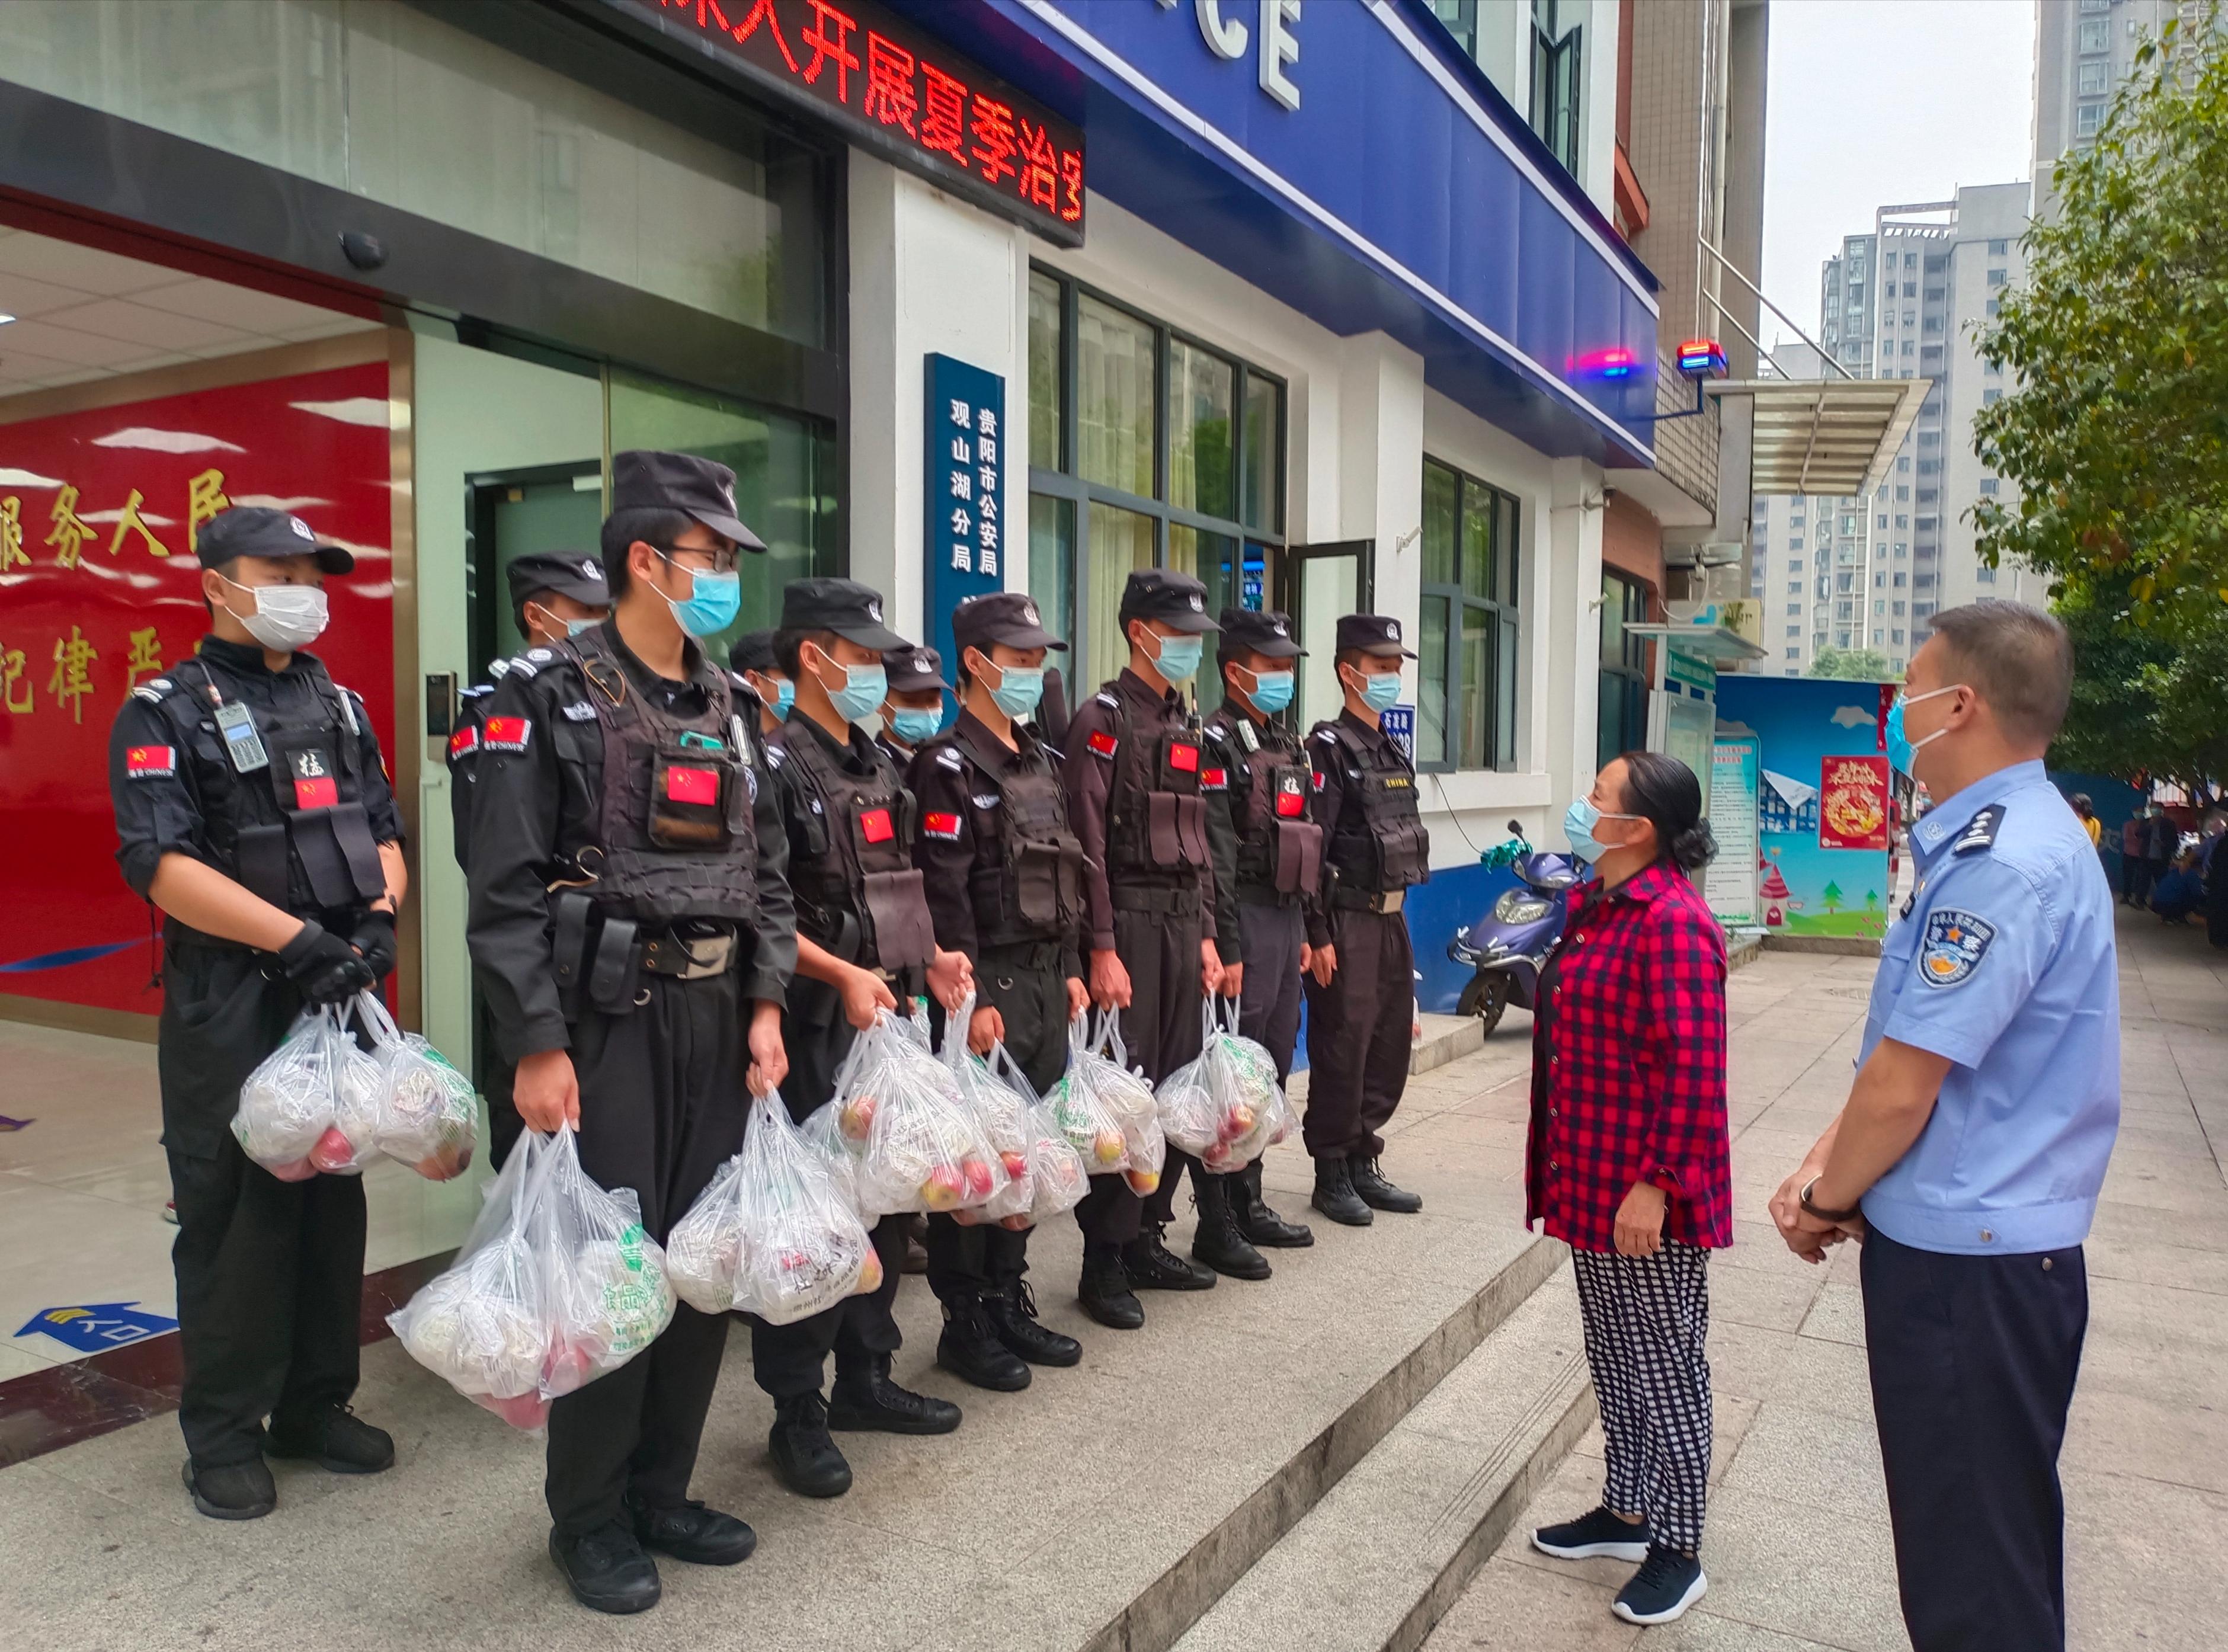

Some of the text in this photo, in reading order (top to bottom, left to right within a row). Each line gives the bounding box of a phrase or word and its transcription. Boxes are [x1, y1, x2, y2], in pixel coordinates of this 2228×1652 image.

[1159, 0, 1301, 113] CE
[950, 398, 971, 573] 观山湖分局
[978, 408, 997, 577] 贵阳市公安局
[0, 625, 203, 725] 纪律严
[1385, 777, 1409, 788] CHINA
